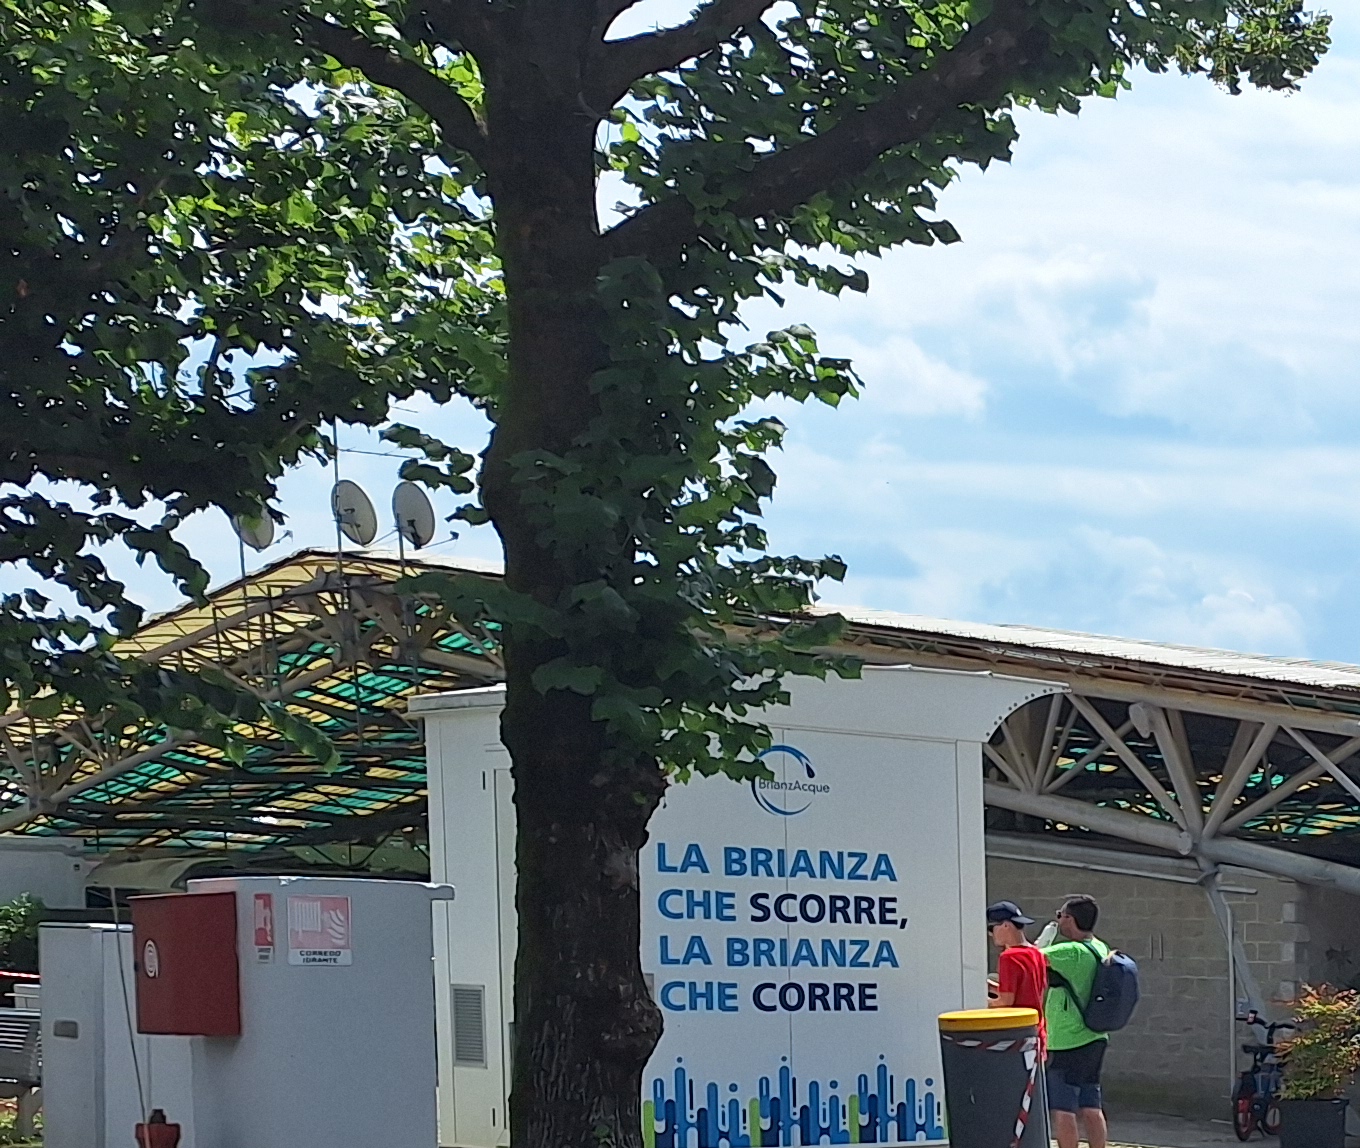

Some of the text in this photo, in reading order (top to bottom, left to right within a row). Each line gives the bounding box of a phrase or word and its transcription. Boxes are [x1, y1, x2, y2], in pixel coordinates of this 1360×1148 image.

[759, 780, 830, 795] BrianzAcque
[657, 843, 898, 882] LA BRIANZA
[658, 889, 908, 930] CHE SCORRE,
[660, 935, 900, 968] LA BRIANZA
[660, 981, 878, 1012] CHE CORRE
